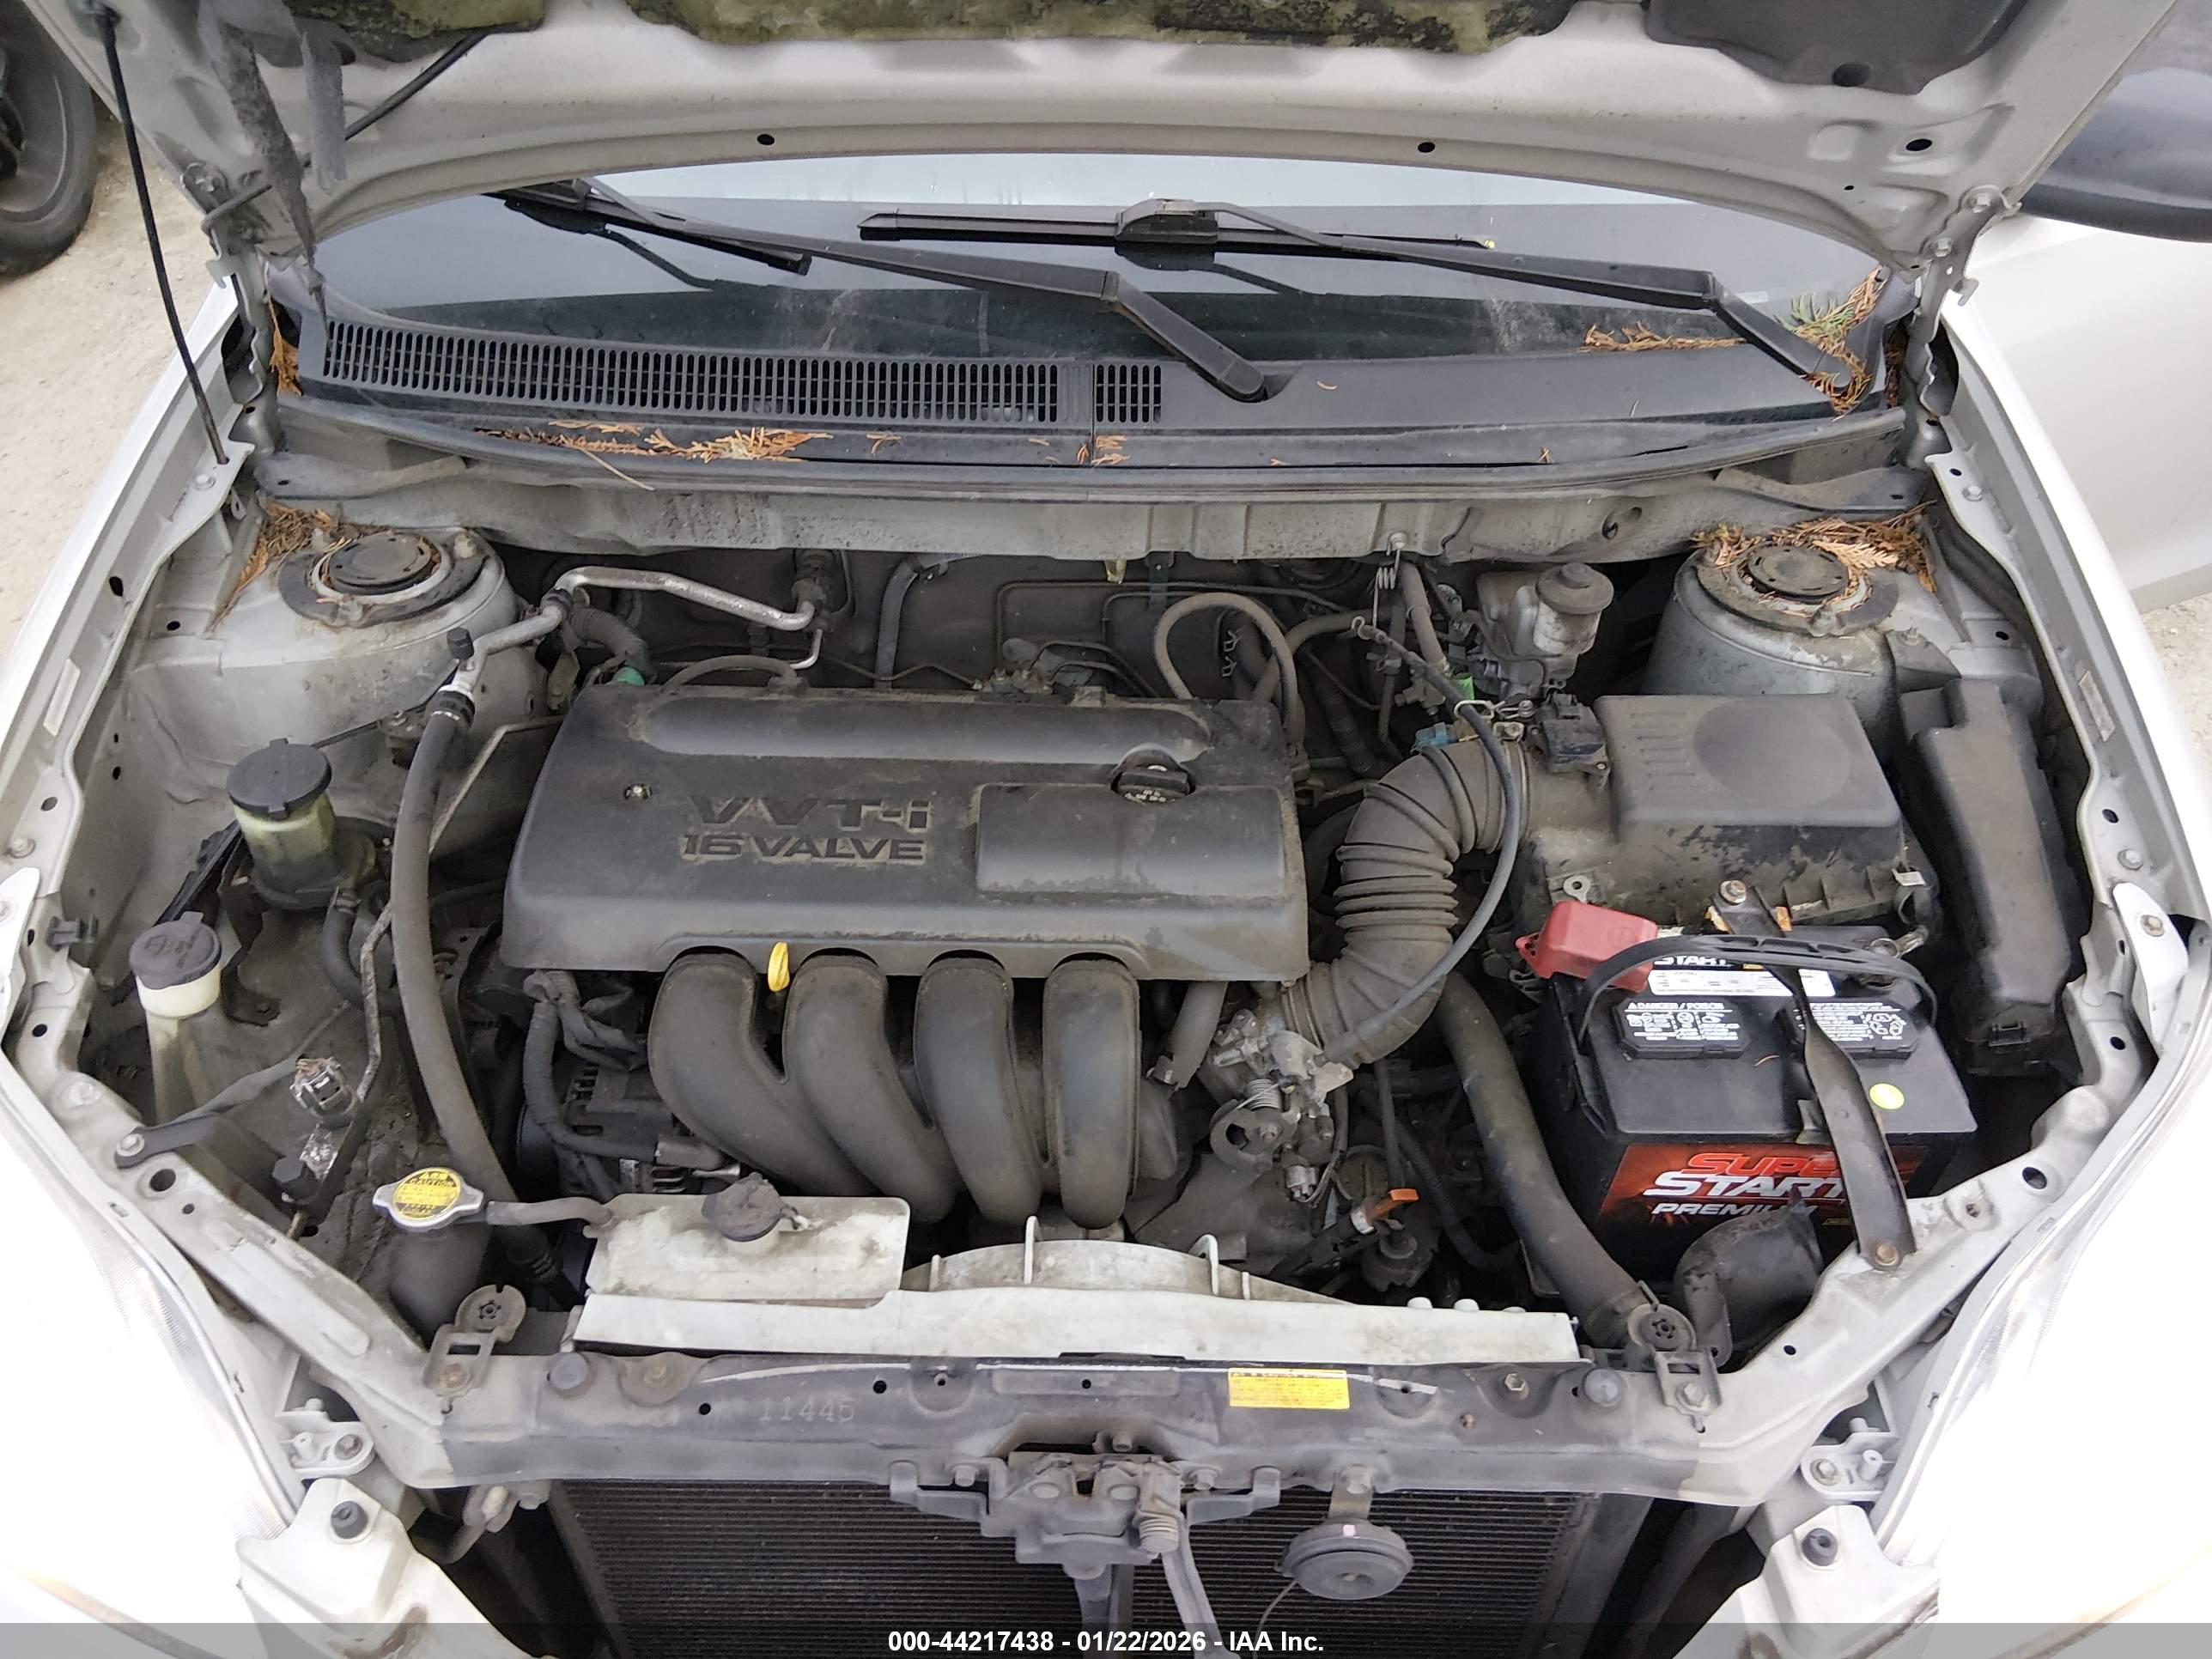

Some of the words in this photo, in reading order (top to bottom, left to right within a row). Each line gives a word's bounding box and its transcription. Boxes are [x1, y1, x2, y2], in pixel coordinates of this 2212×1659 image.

[690, 796, 930, 830] VVT-i
[749, 836, 927, 860] VALVE
[1680, 1152, 1840, 1176] SUPE
[1643, 1171, 1845, 1198] START
